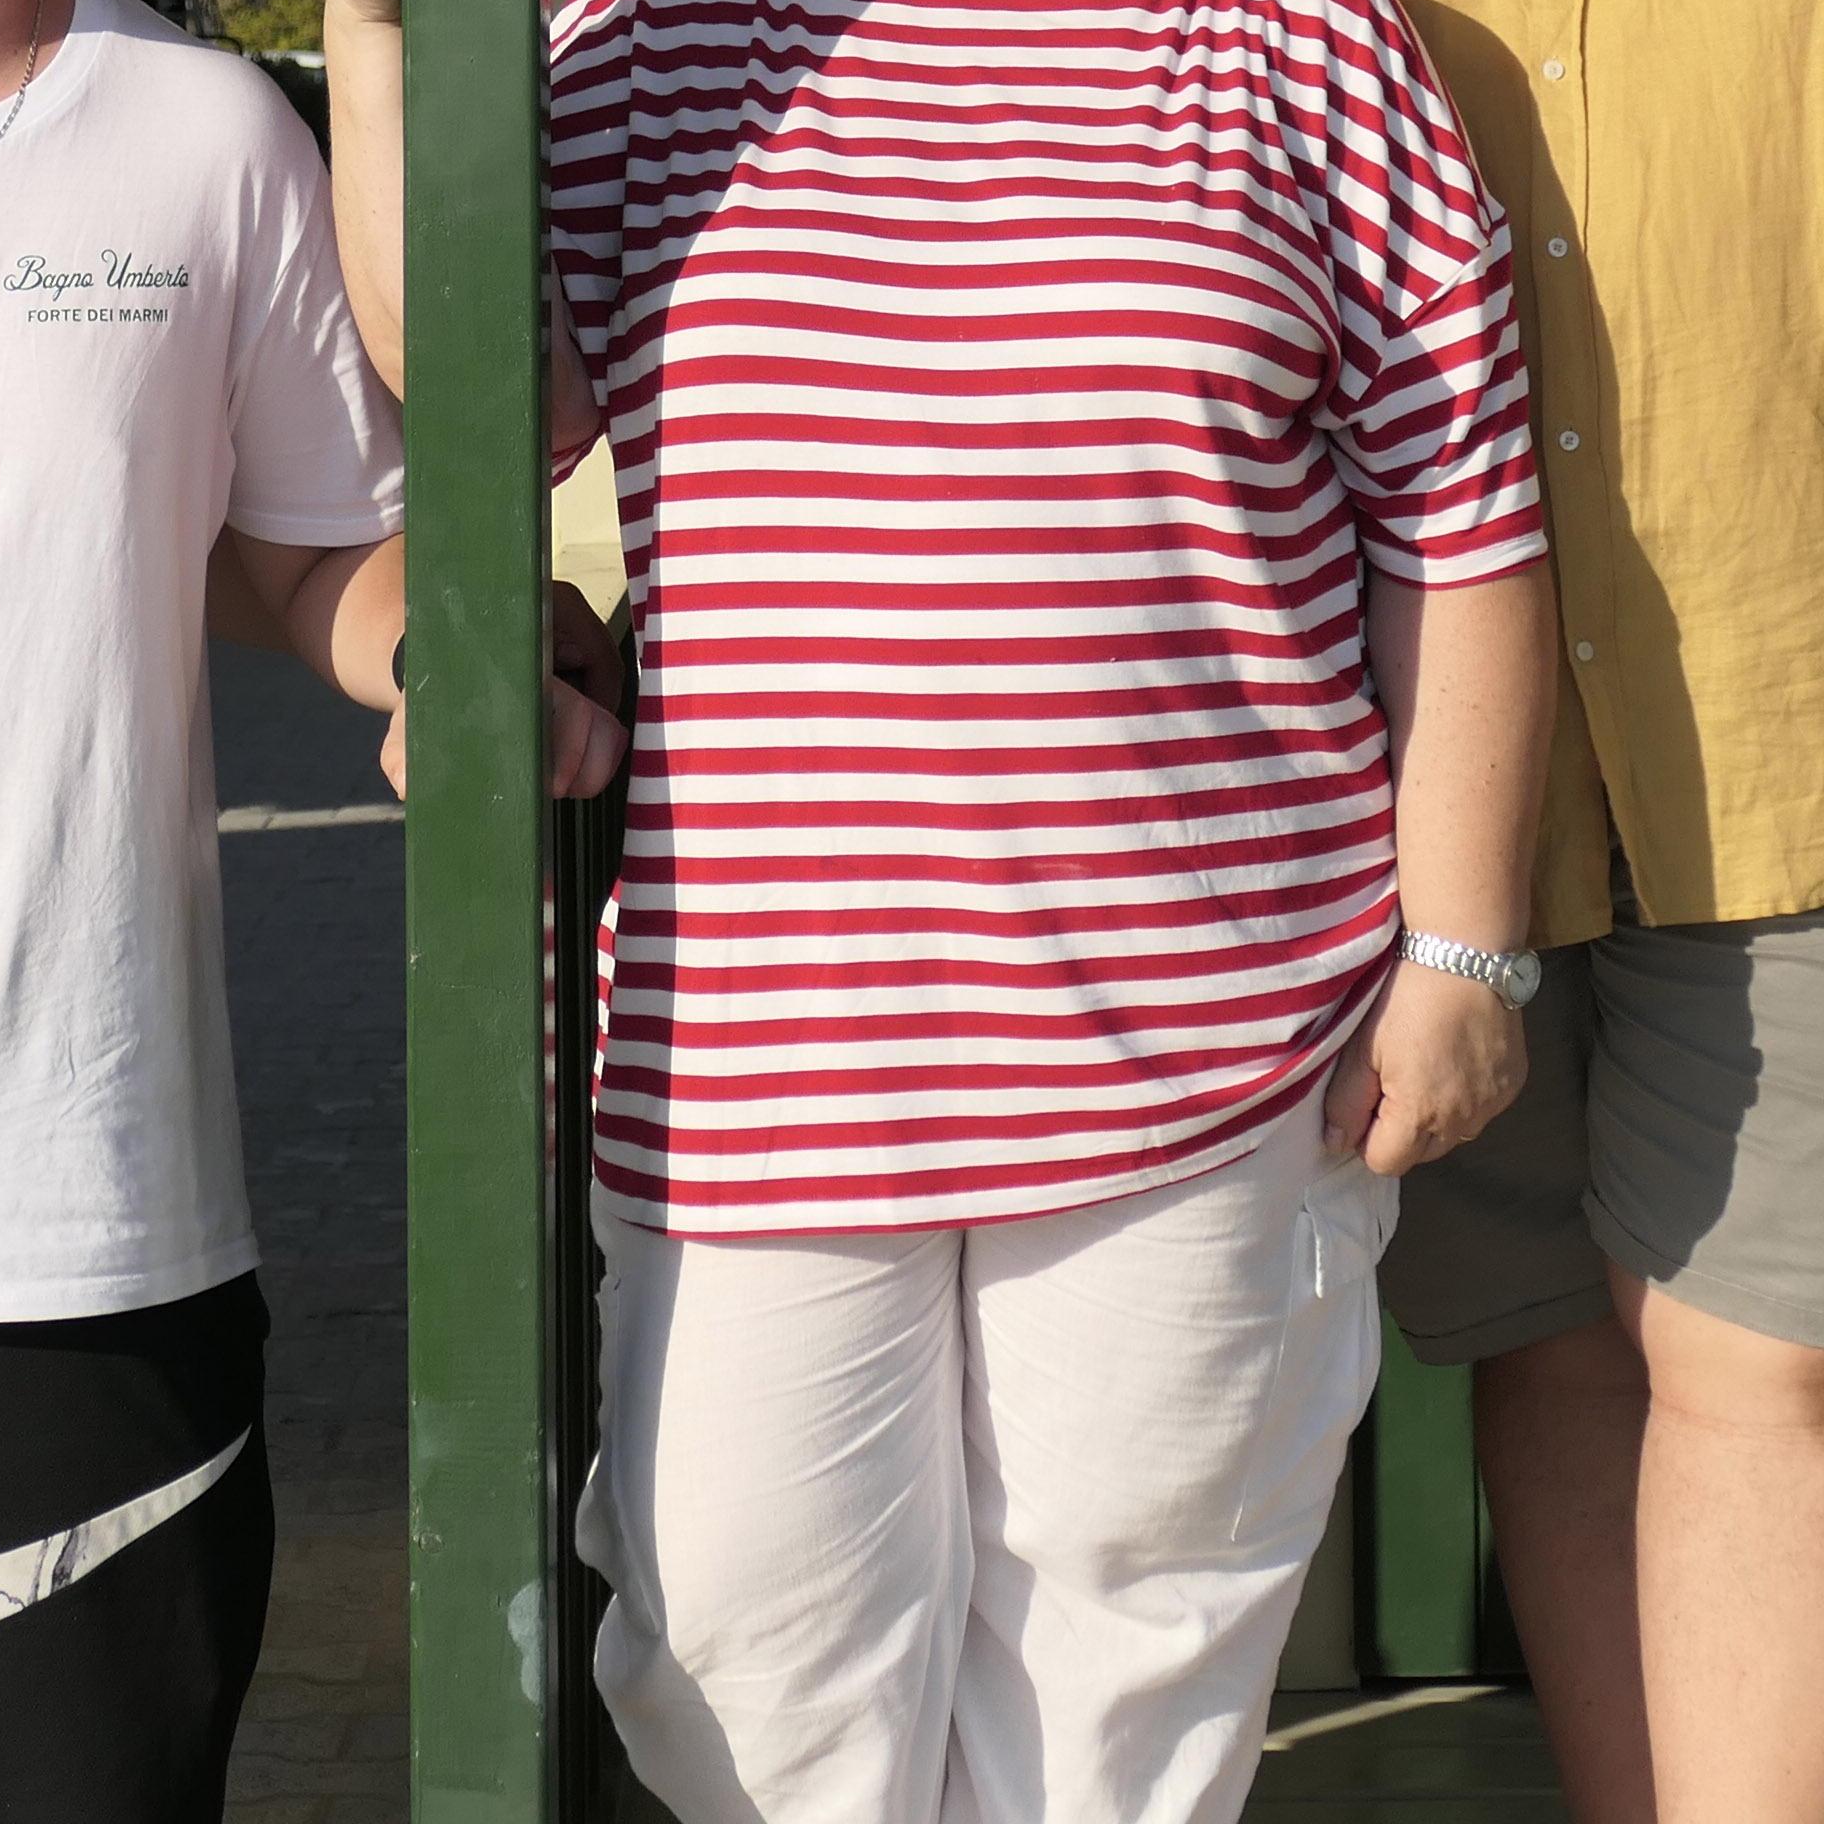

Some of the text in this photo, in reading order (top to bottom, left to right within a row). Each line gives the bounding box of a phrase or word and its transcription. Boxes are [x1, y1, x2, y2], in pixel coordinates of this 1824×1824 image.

[3, 249, 190, 301] Bagno Umberto
[27, 308, 169, 323] FORTE DEI MARMI
